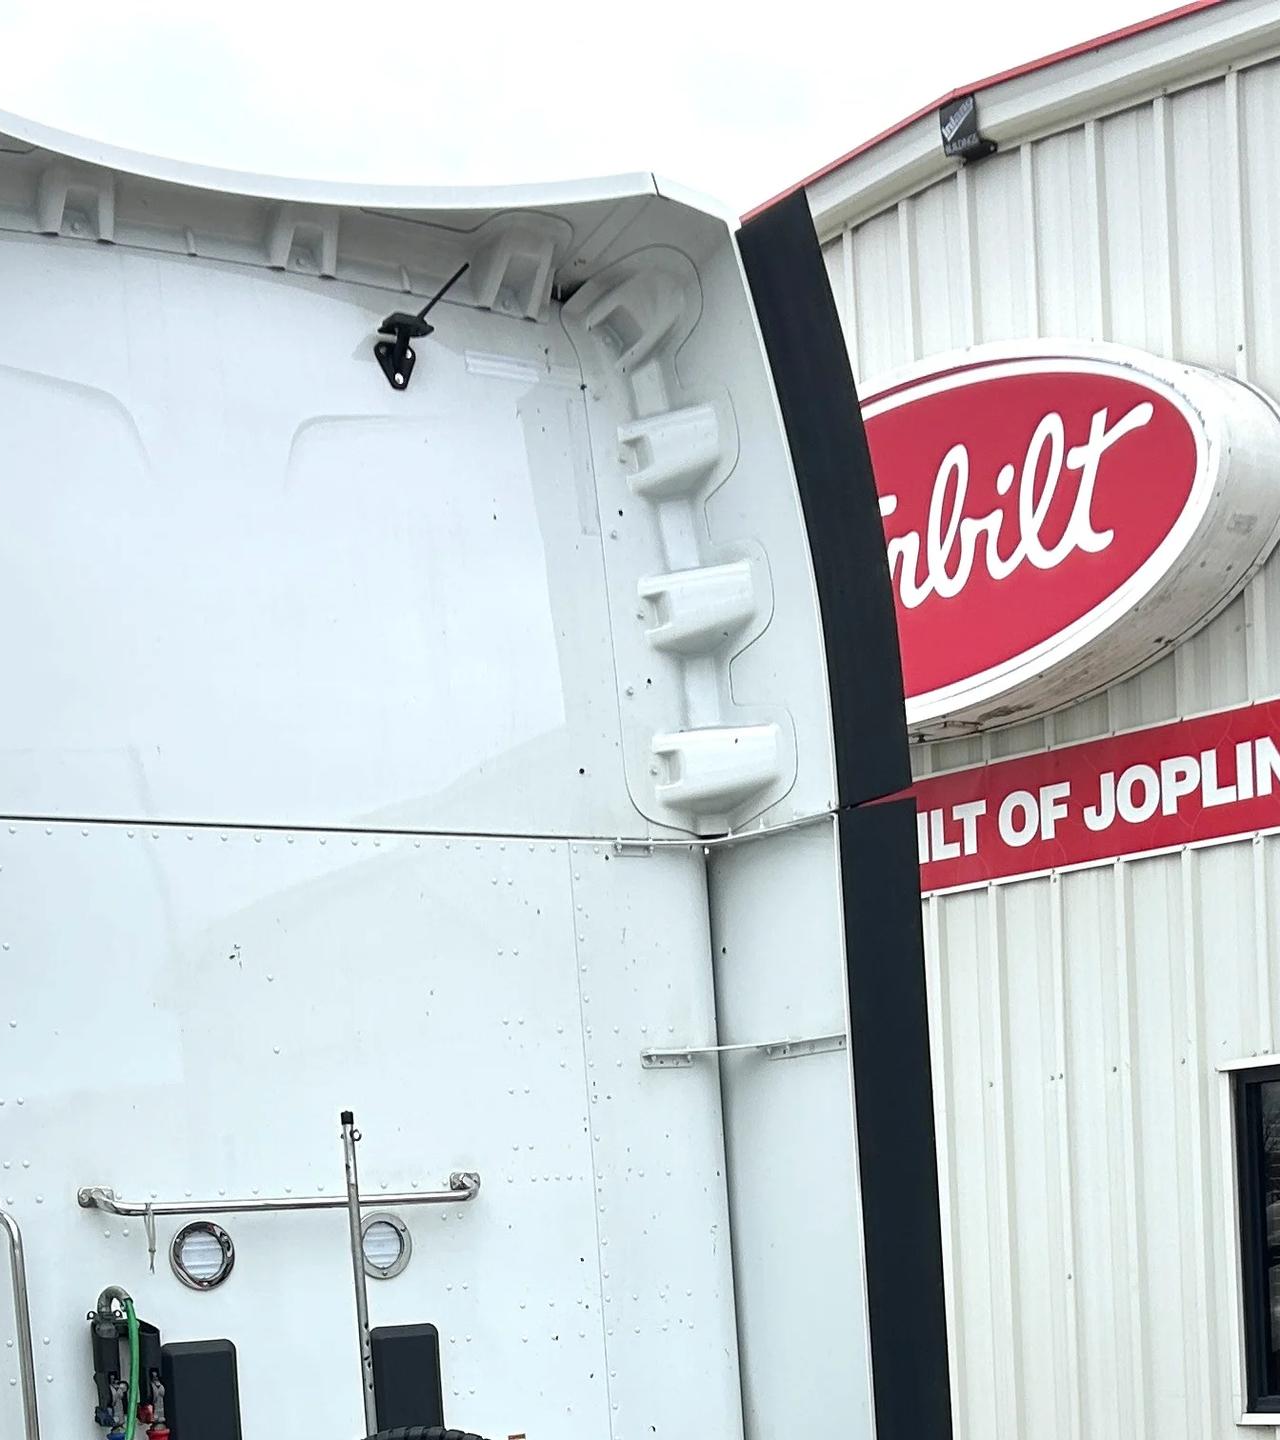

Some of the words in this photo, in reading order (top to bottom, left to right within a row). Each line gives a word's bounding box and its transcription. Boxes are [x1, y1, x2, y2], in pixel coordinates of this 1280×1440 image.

[879, 402, 1153, 608] rbilt
[917, 799, 987, 864] ILT
[998, 781, 1069, 846] OF
